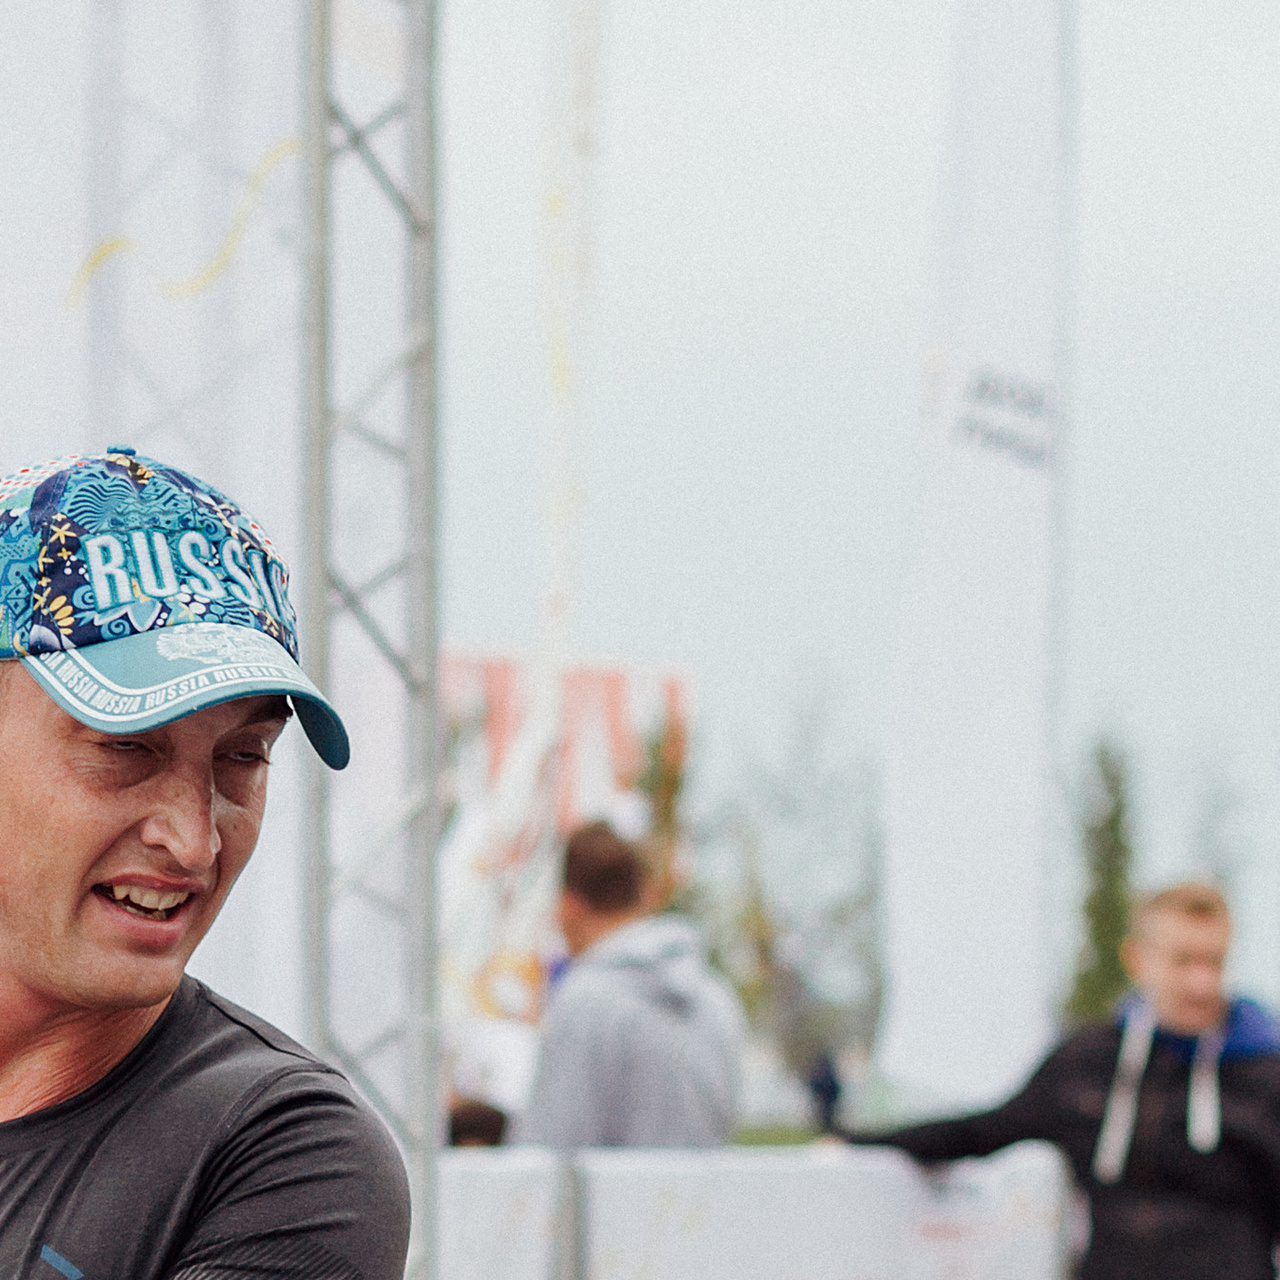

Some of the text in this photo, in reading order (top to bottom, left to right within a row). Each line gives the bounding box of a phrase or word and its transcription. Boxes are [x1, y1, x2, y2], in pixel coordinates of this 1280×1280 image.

[56, 659, 99, 702] RUSSIA
[89, 688, 142, 714] RUSSIA
[144, 675, 211, 710] RUSSIA
[213, 667, 282, 683] RUSSIA
